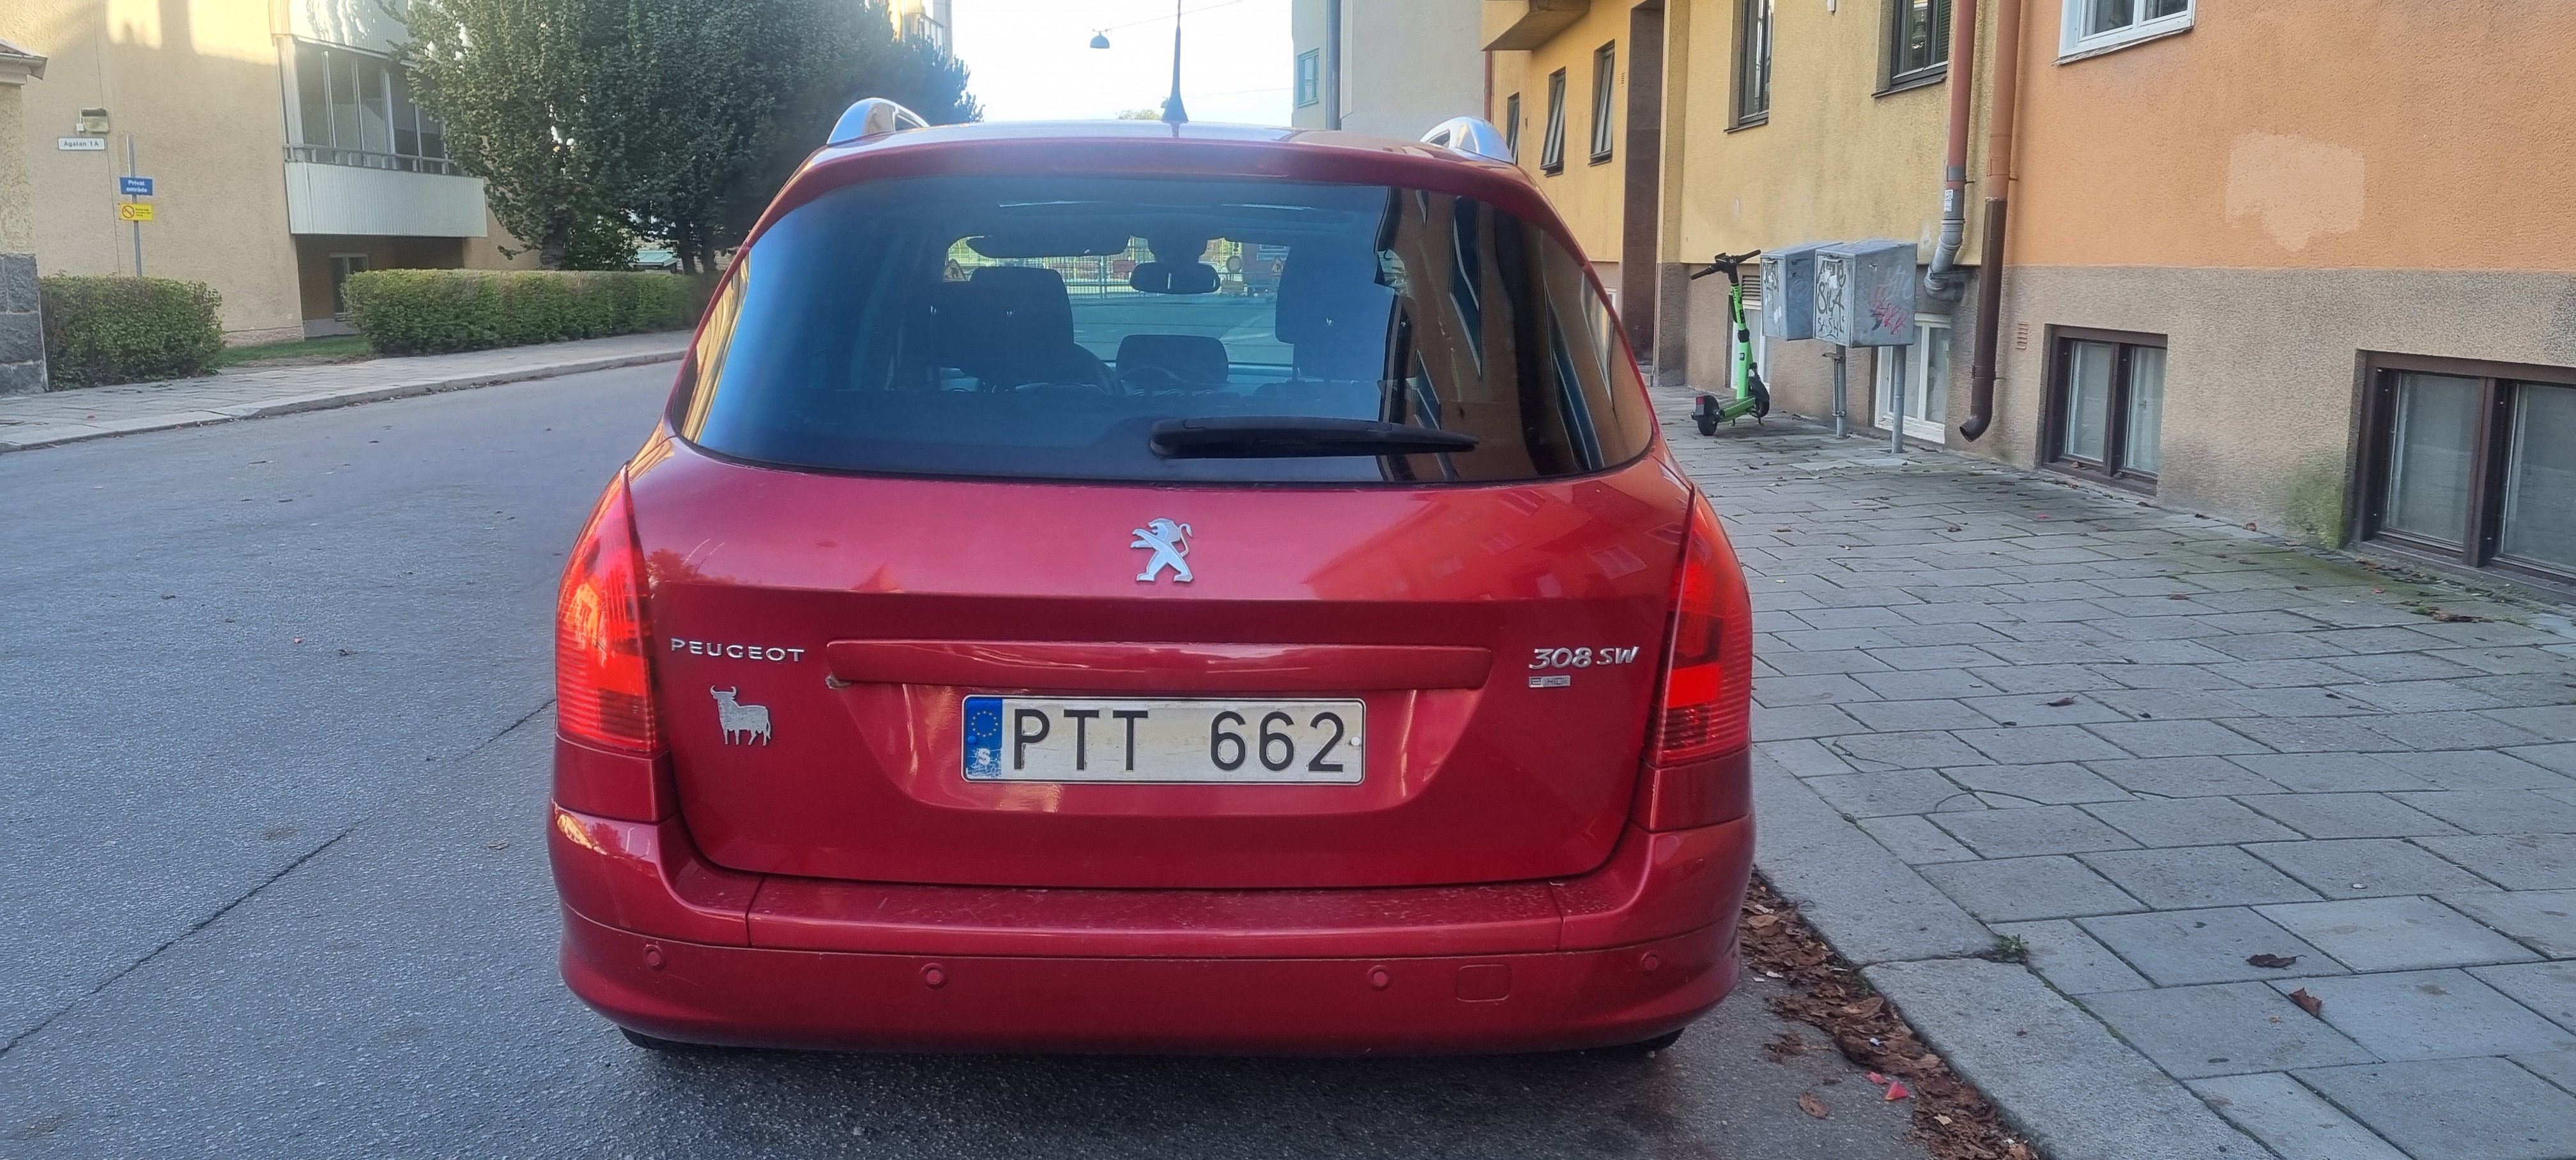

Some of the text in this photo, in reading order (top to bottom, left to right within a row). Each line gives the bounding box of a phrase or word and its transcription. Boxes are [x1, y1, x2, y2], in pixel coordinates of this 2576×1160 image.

[671, 638, 804, 662] PEUGEOT
[1529, 646, 1639, 669] 308 SW
[1013, 708, 1344, 772] PTT 662
[978, 748, 991, 766] S
